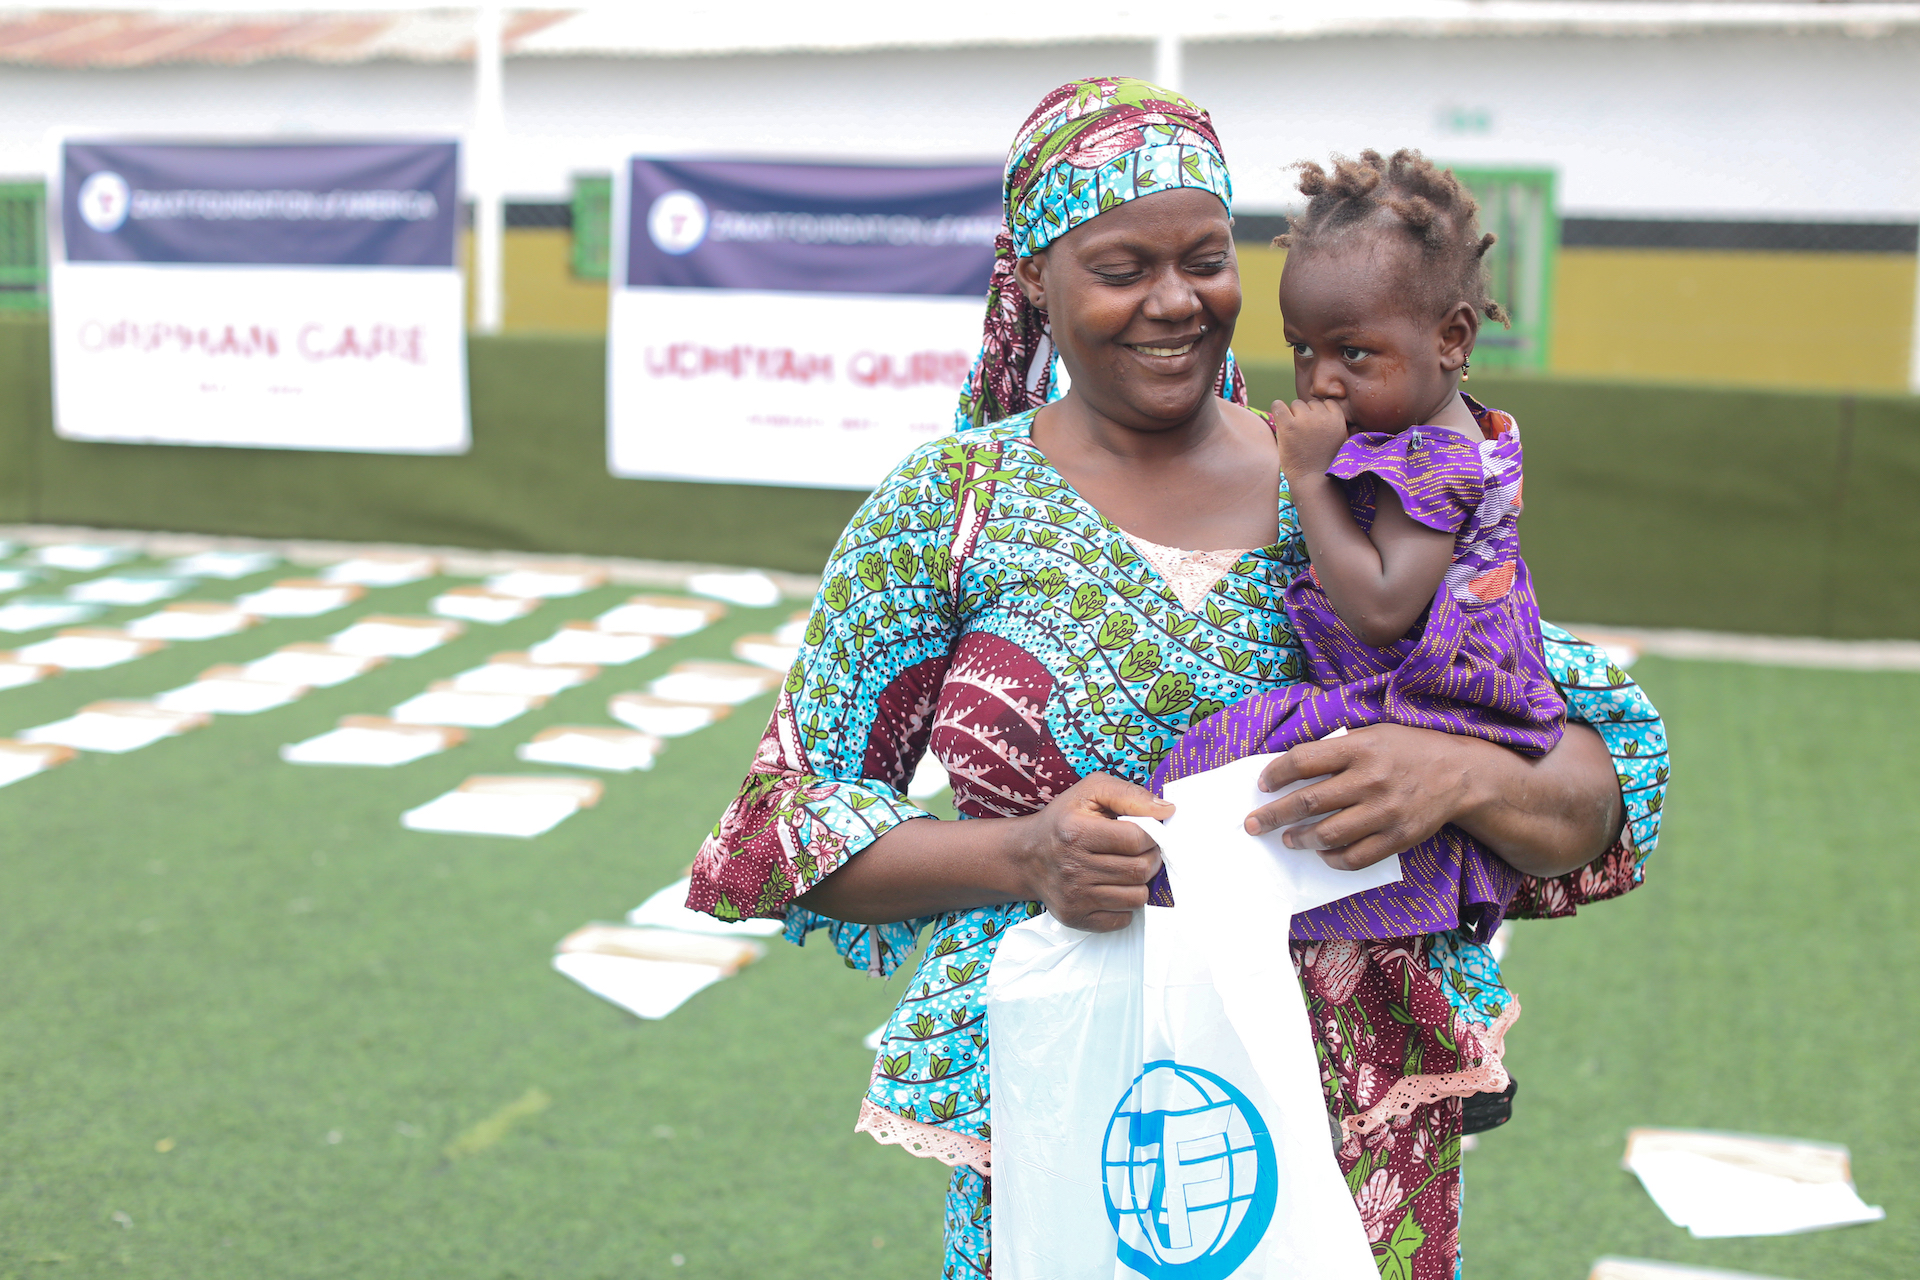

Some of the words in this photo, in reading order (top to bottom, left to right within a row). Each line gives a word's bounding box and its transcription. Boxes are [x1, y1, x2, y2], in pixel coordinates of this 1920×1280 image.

[79, 319, 280, 358] ORPHAN
[297, 321, 428, 366] CARE
[846, 348, 971, 391] QURB
